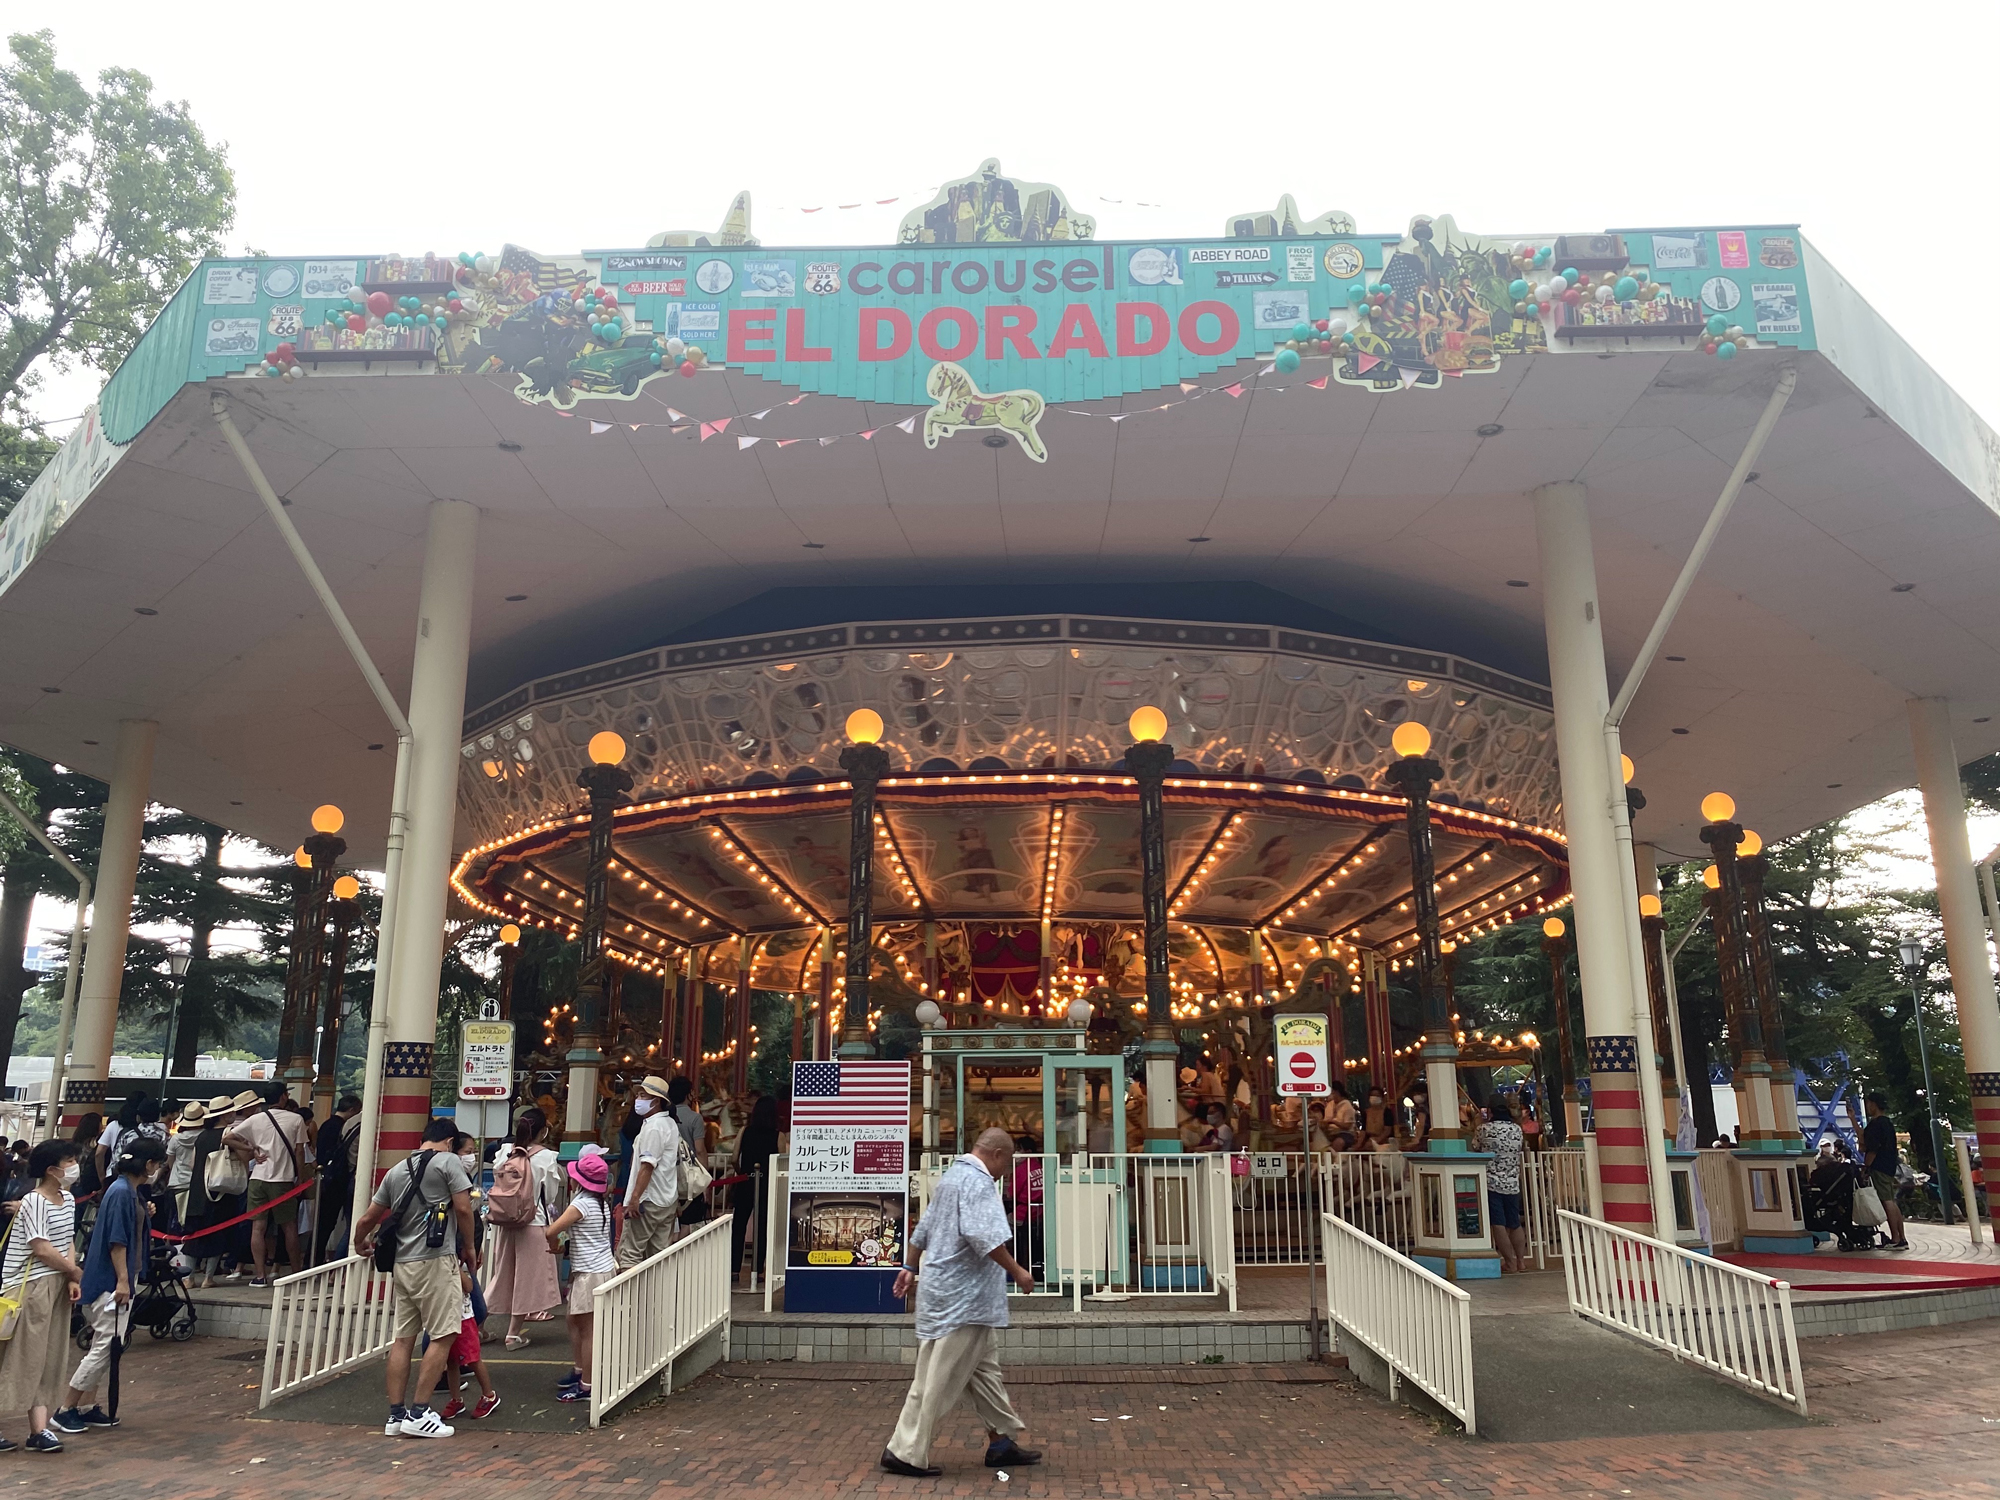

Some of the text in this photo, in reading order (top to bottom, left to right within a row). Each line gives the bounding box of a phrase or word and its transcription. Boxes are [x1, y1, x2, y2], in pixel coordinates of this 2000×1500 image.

[1192, 249, 1268, 261] ABBEY ROAD
[1767, 254, 1790, 266] 66
[308, 265, 328, 274] 1934
[847, 246, 1114, 295] carousel
[1232, 274, 1262, 283] TRAINS
[642, 282, 667, 293] BEER
[812, 280, 833, 292] 66
[275, 322, 296, 334] 66
[726, 301, 1240, 362] EL DORADO
[796, 1145, 851, 1156] カルーセル
[795, 1161, 850, 1172] エルドラド
[1258, 1157, 1281, 1168] 出口
